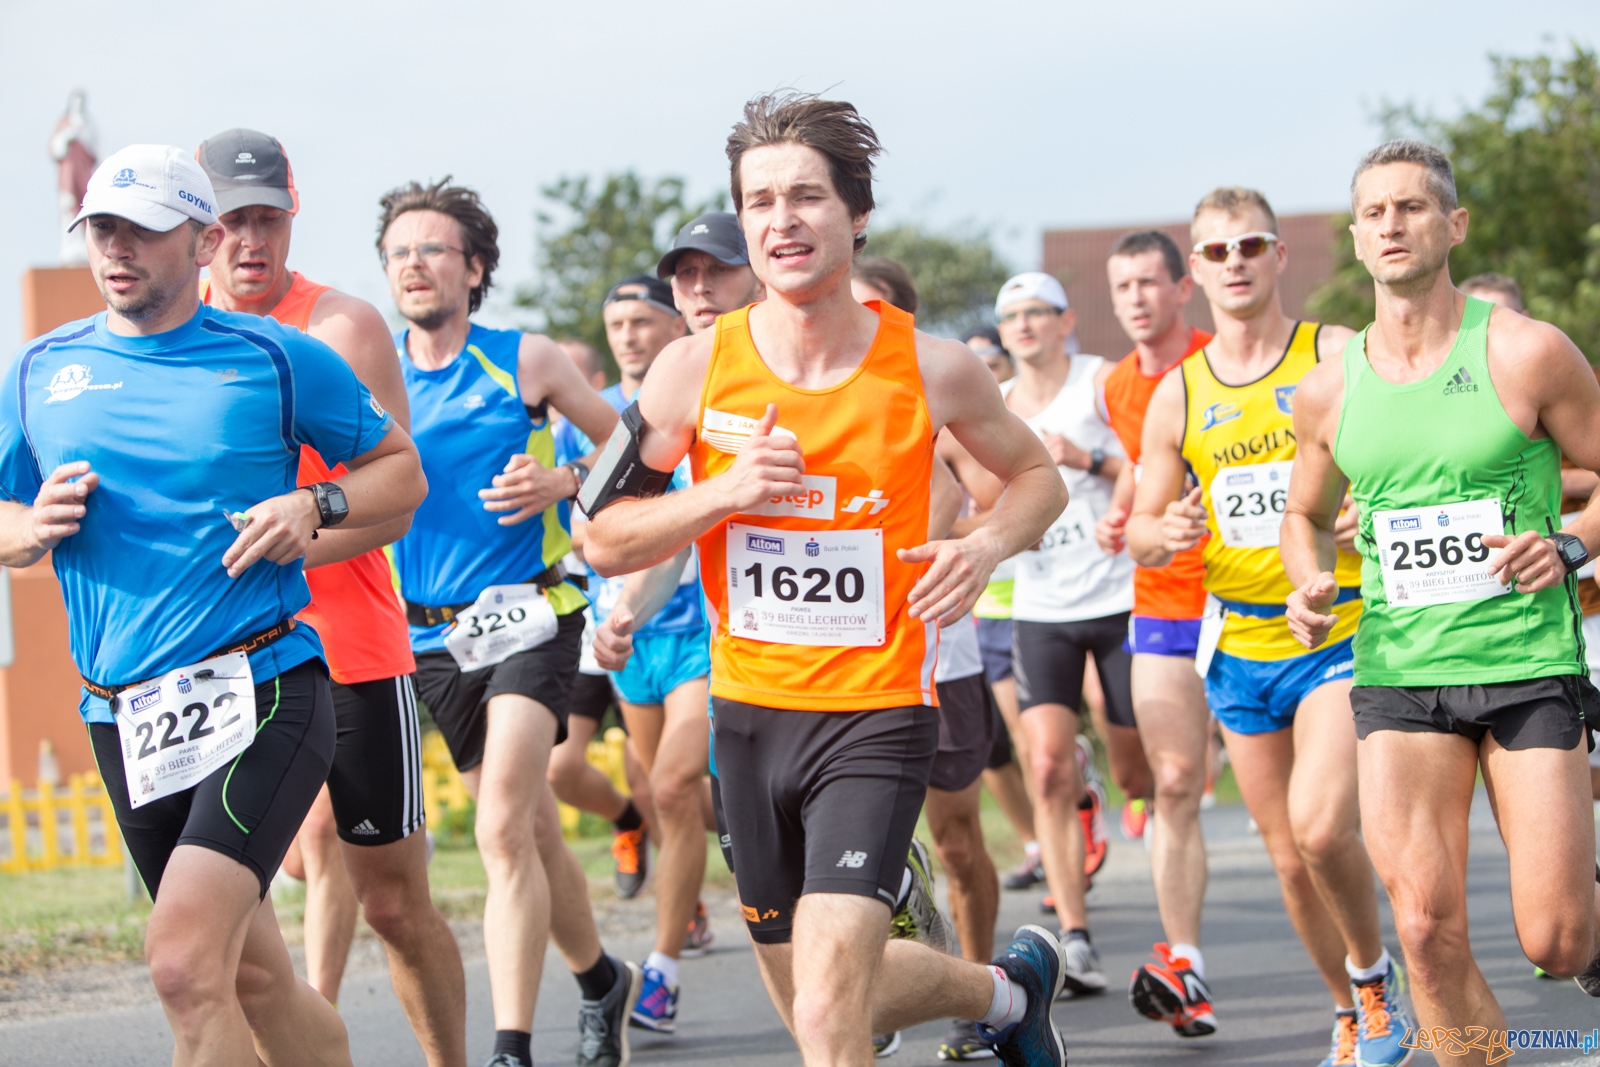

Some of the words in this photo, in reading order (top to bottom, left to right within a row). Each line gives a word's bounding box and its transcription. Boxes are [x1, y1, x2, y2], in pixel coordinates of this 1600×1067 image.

[178, 190, 212, 215] GDYNIA
[1214, 428, 1297, 468] MOGILN
[1226, 490, 1286, 518] 236
[840, 544, 858, 552] Polski
[1042, 523, 1084, 550] 021
[1390, 532, 1490, 570] 2569
[744, 562, 864, 604] 1620
[1409, 578, 1420, 589] 39
[1422, 576, 1445, 588] BIEG
[466, 607, 526, 638] 320
[762, 612, 774, 622] 39
[778, 613, 804, 624] BIEG
[808, 613, 868, 625] LECHITÓW
[135, 692, 241, 760] 2222
[154, 764, 166, 776] 39
[168, 756, 196, 770] BIEG
